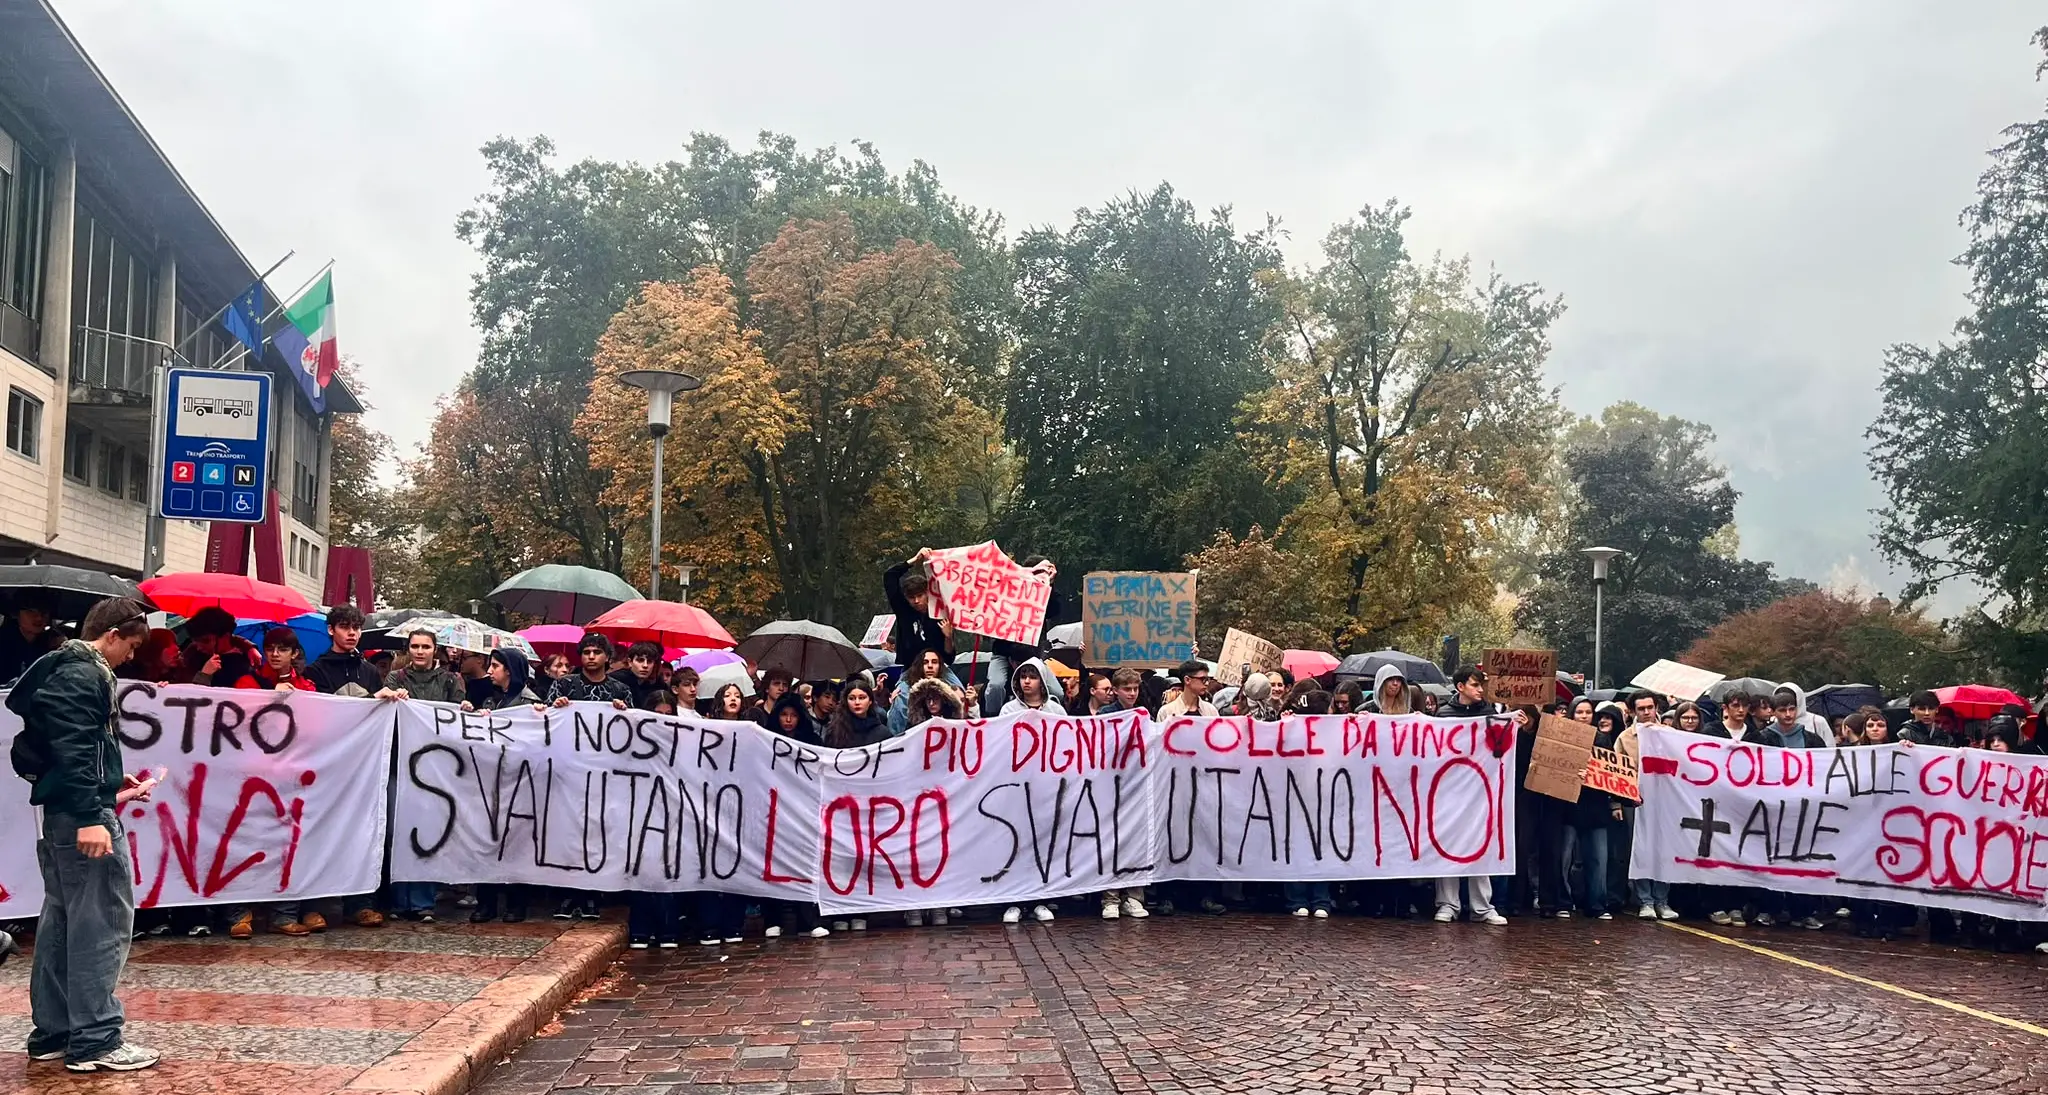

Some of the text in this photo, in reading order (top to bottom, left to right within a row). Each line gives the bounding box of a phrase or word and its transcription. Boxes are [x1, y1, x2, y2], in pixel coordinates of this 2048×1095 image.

[178, 466, 251, 482] 2 4 N
[930, 558, 1049, 606] OBBEDIENTI
[1087, 575, 1167, 598] EMPATIA
[951, 586, 1045, 626] AVRETE
[1176, 601, 1192, 618] E
[1091, 619, 1191, 643] NON PER
[118, 683, 296, 756] STRO
[434, 707, 1477, 781] PER I NOSTRI PROF PIÙ DIGNITÀ COLLE DA VINCI
[1622, 756, 1635, 770] IL
[1604, 764, 1634, 777] SENZA
[1681, 741, 1815, 788] SOLDI
[1825, 749, 1911, 798] ALLE
[409, 743, 1505, 896] SVALUTANO LORO SVALUTANO NOI
[1738, 798, 1849, 865] ALLE
